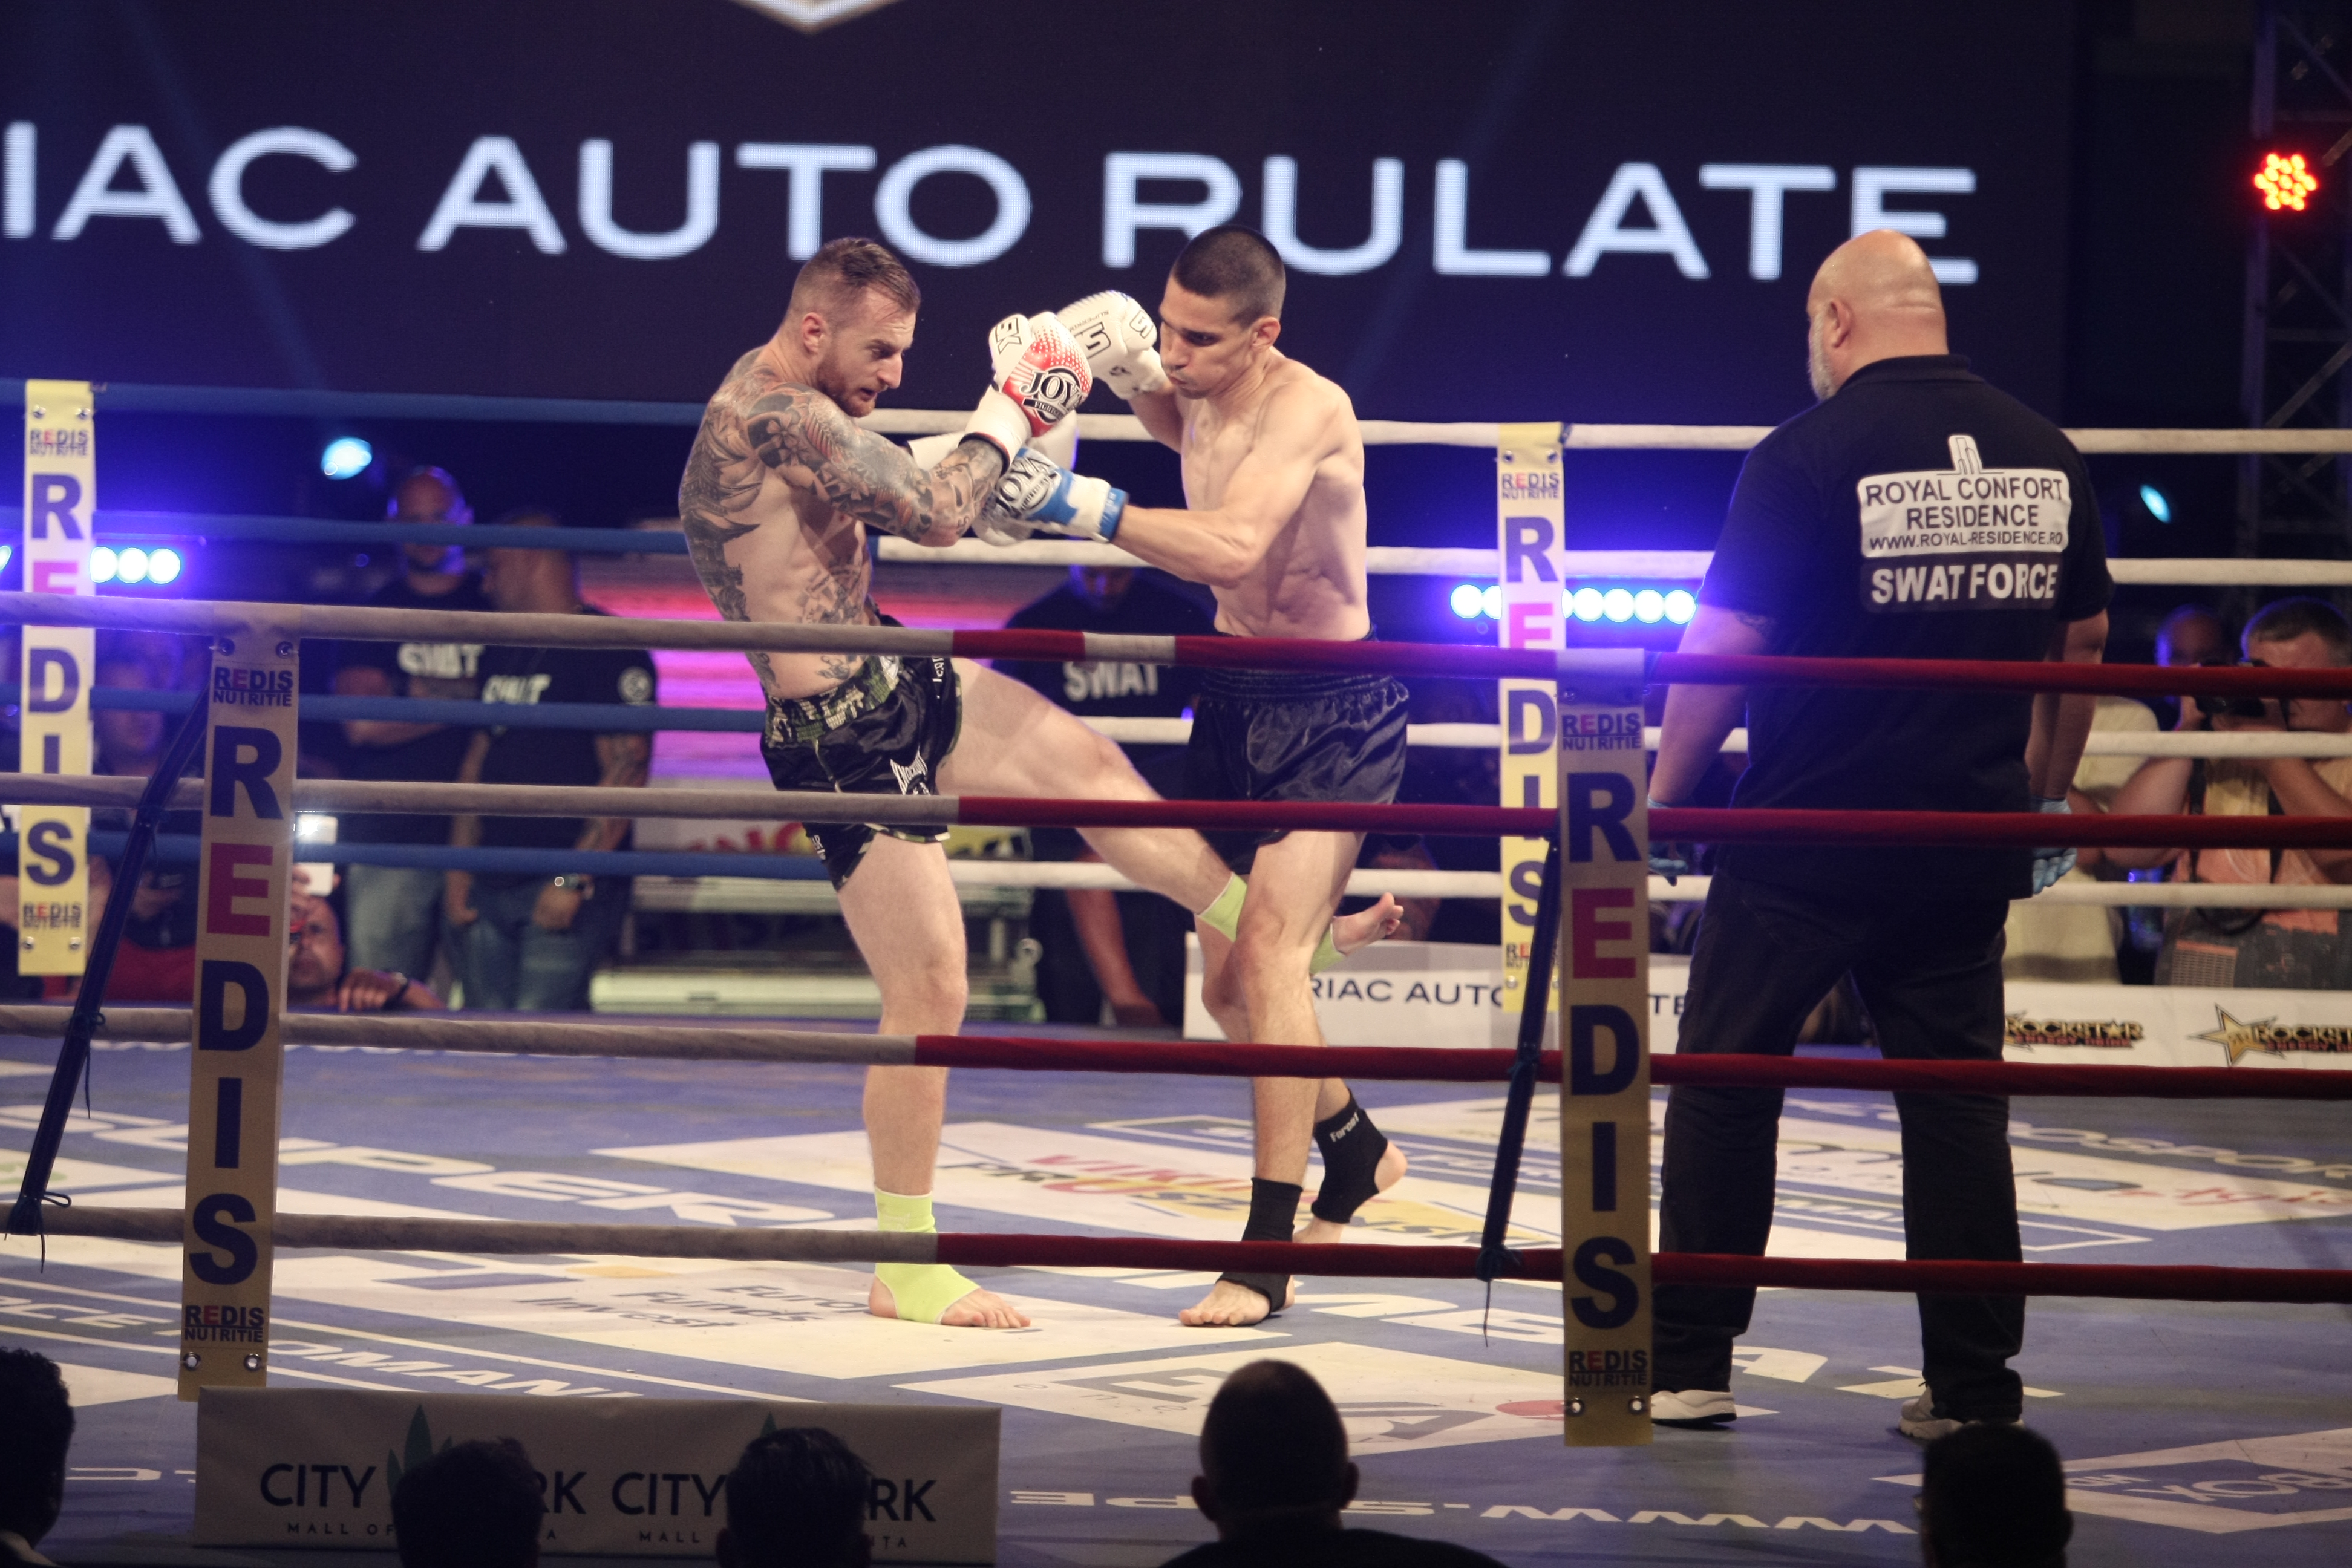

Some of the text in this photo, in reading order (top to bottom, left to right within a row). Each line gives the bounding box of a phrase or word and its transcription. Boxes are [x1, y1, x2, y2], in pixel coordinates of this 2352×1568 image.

[416, 135, 1032, 267] AUTO
[1101, 151, 1979, 283] RULATE
[1501, 472, 1560, 488] REDIS
[1865, 477, 2063, 506] ROYAL CONFORT
[1907, 504, 2039, 530] RESIDENCE
[1869, 531, 2063, 550] WWW.ROYAL-RESIDENCE.RO
[1871, 563, 2059, 604] SWAT FORCE
[214, 665, 293, 691] REDIS
[212, 690, 292, 707] NUTRITIE
[1561, 713, 1641, 735] REDIS
[1561, 735, 1642, 750] NUTRITIE
[188, 725, 284, 1287] REDIS
[1569, 771, 1643, 1330] REDIS
[185, 1305, 265, 1328] REDIS
[183, 1328, 264, 1344] NUTRITIE
[1569, 1349, 1648, 1371] REDIS
[1568, 1371, 1648, 1389] NUTRITIE
[260, 1463, 377, 1508] CITY
[611, 1472, 727, 1517] CITY
[287, 1522, 395, 1537] MALL OF
[639, 1530, 701, 1544] MALL
